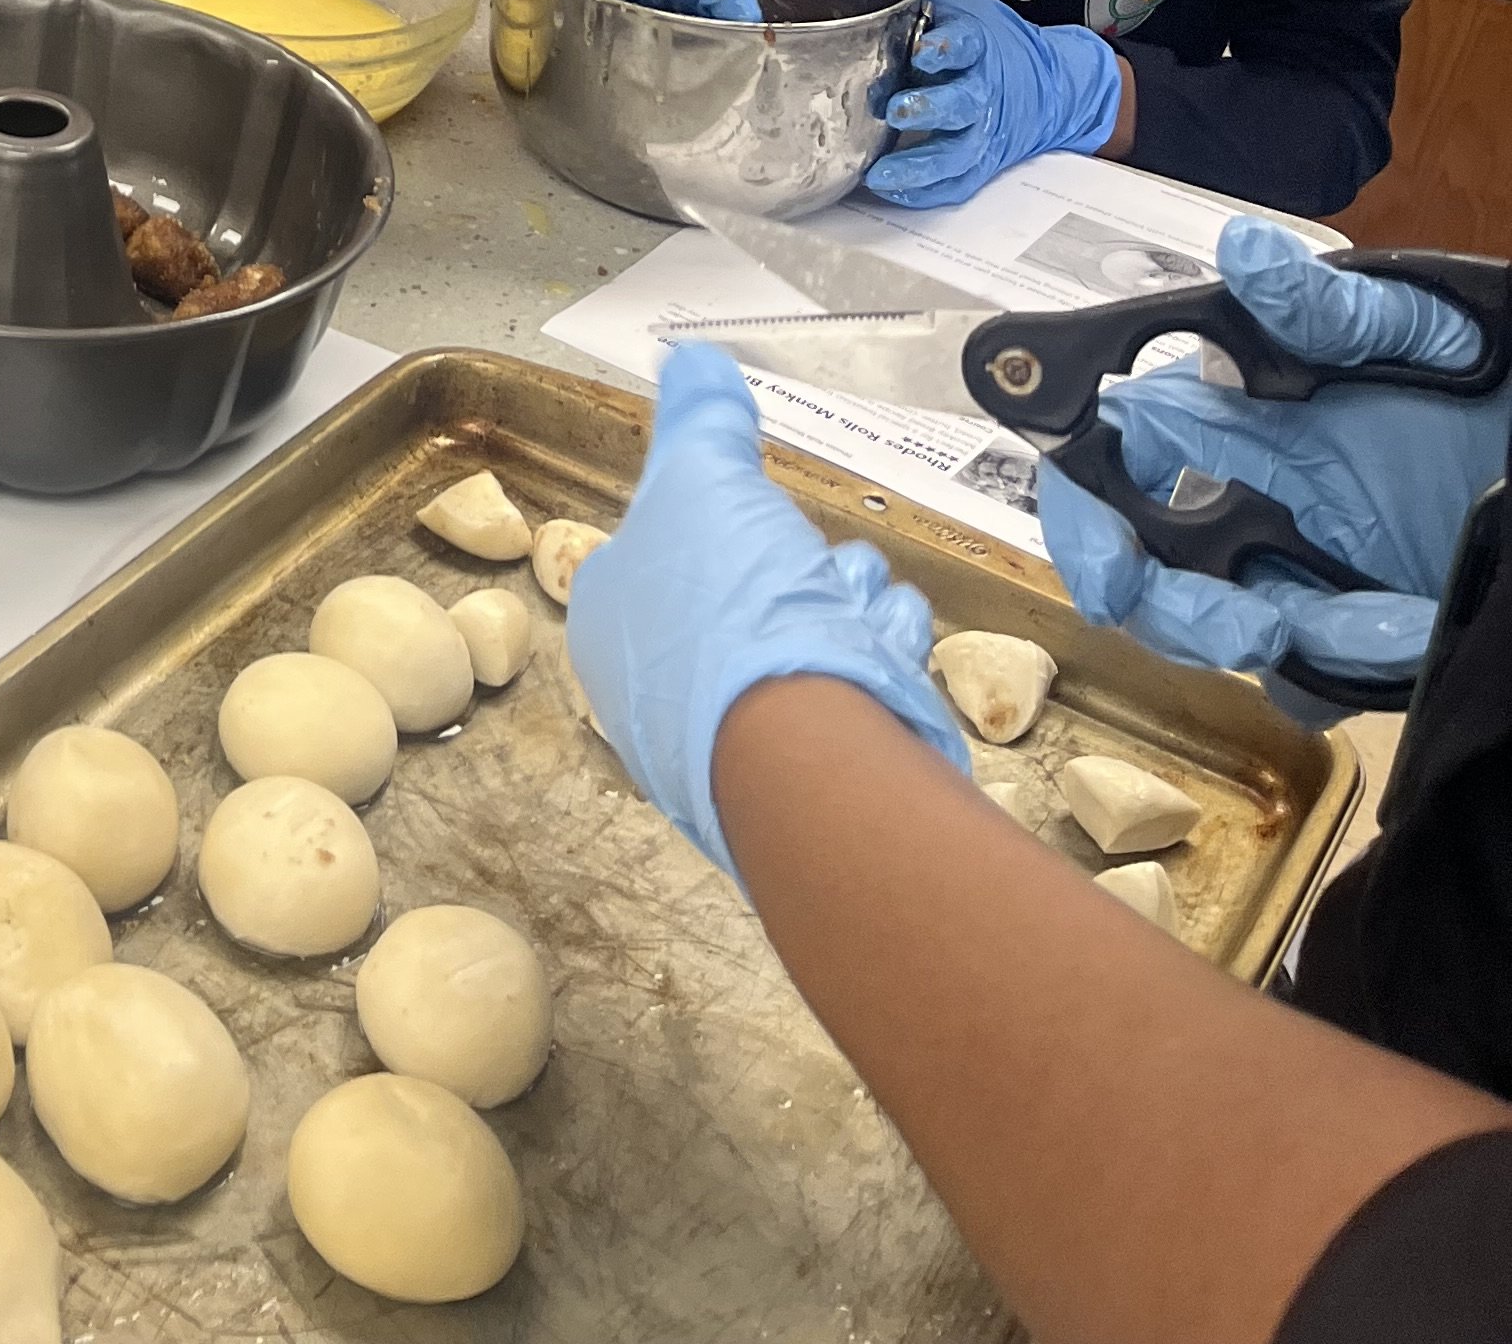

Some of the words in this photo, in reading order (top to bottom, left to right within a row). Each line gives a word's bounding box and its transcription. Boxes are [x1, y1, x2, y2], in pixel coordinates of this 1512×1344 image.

[766, 384, 835, 420] Monkey
[840, 417, 881, 442] Rolls
[885, 438, 952, 472] Rhodes
